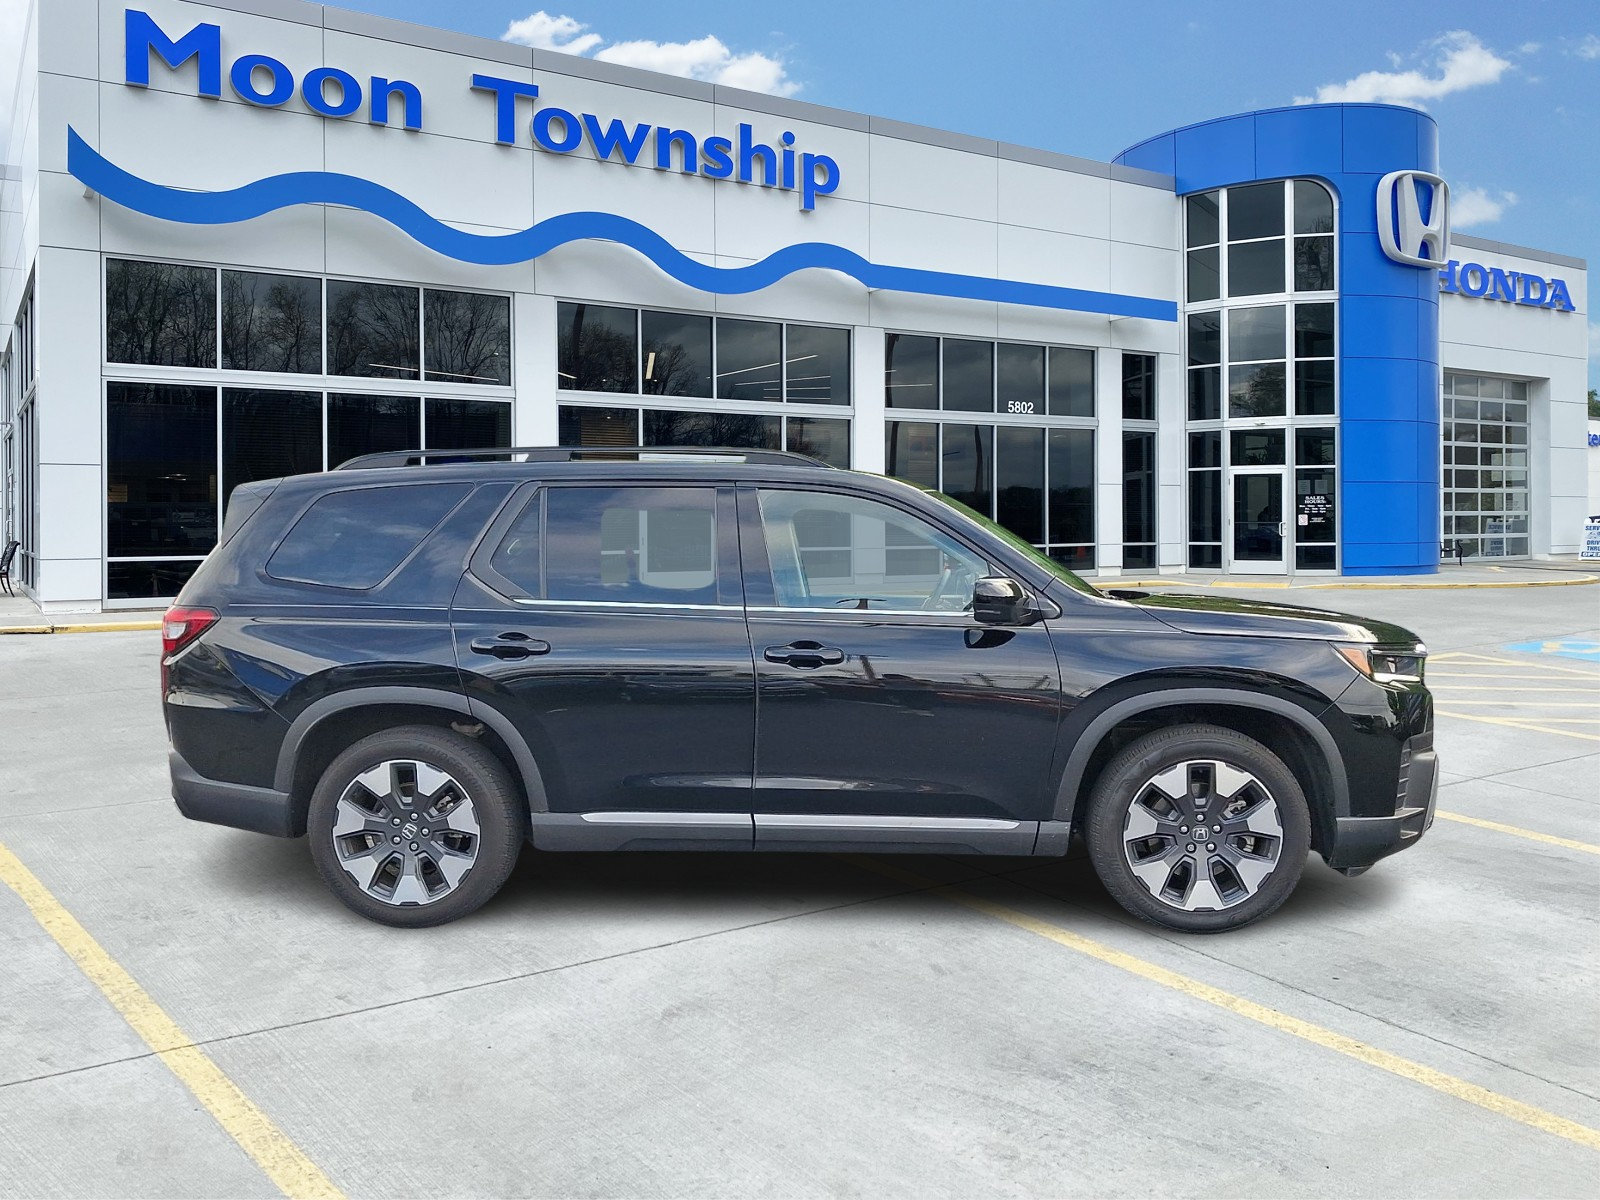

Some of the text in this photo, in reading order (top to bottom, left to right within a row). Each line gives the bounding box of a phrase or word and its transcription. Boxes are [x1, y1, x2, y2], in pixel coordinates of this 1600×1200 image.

[124, 8, 841, 212] Moon Township
[1007, 400, 1034, 414] 5802
